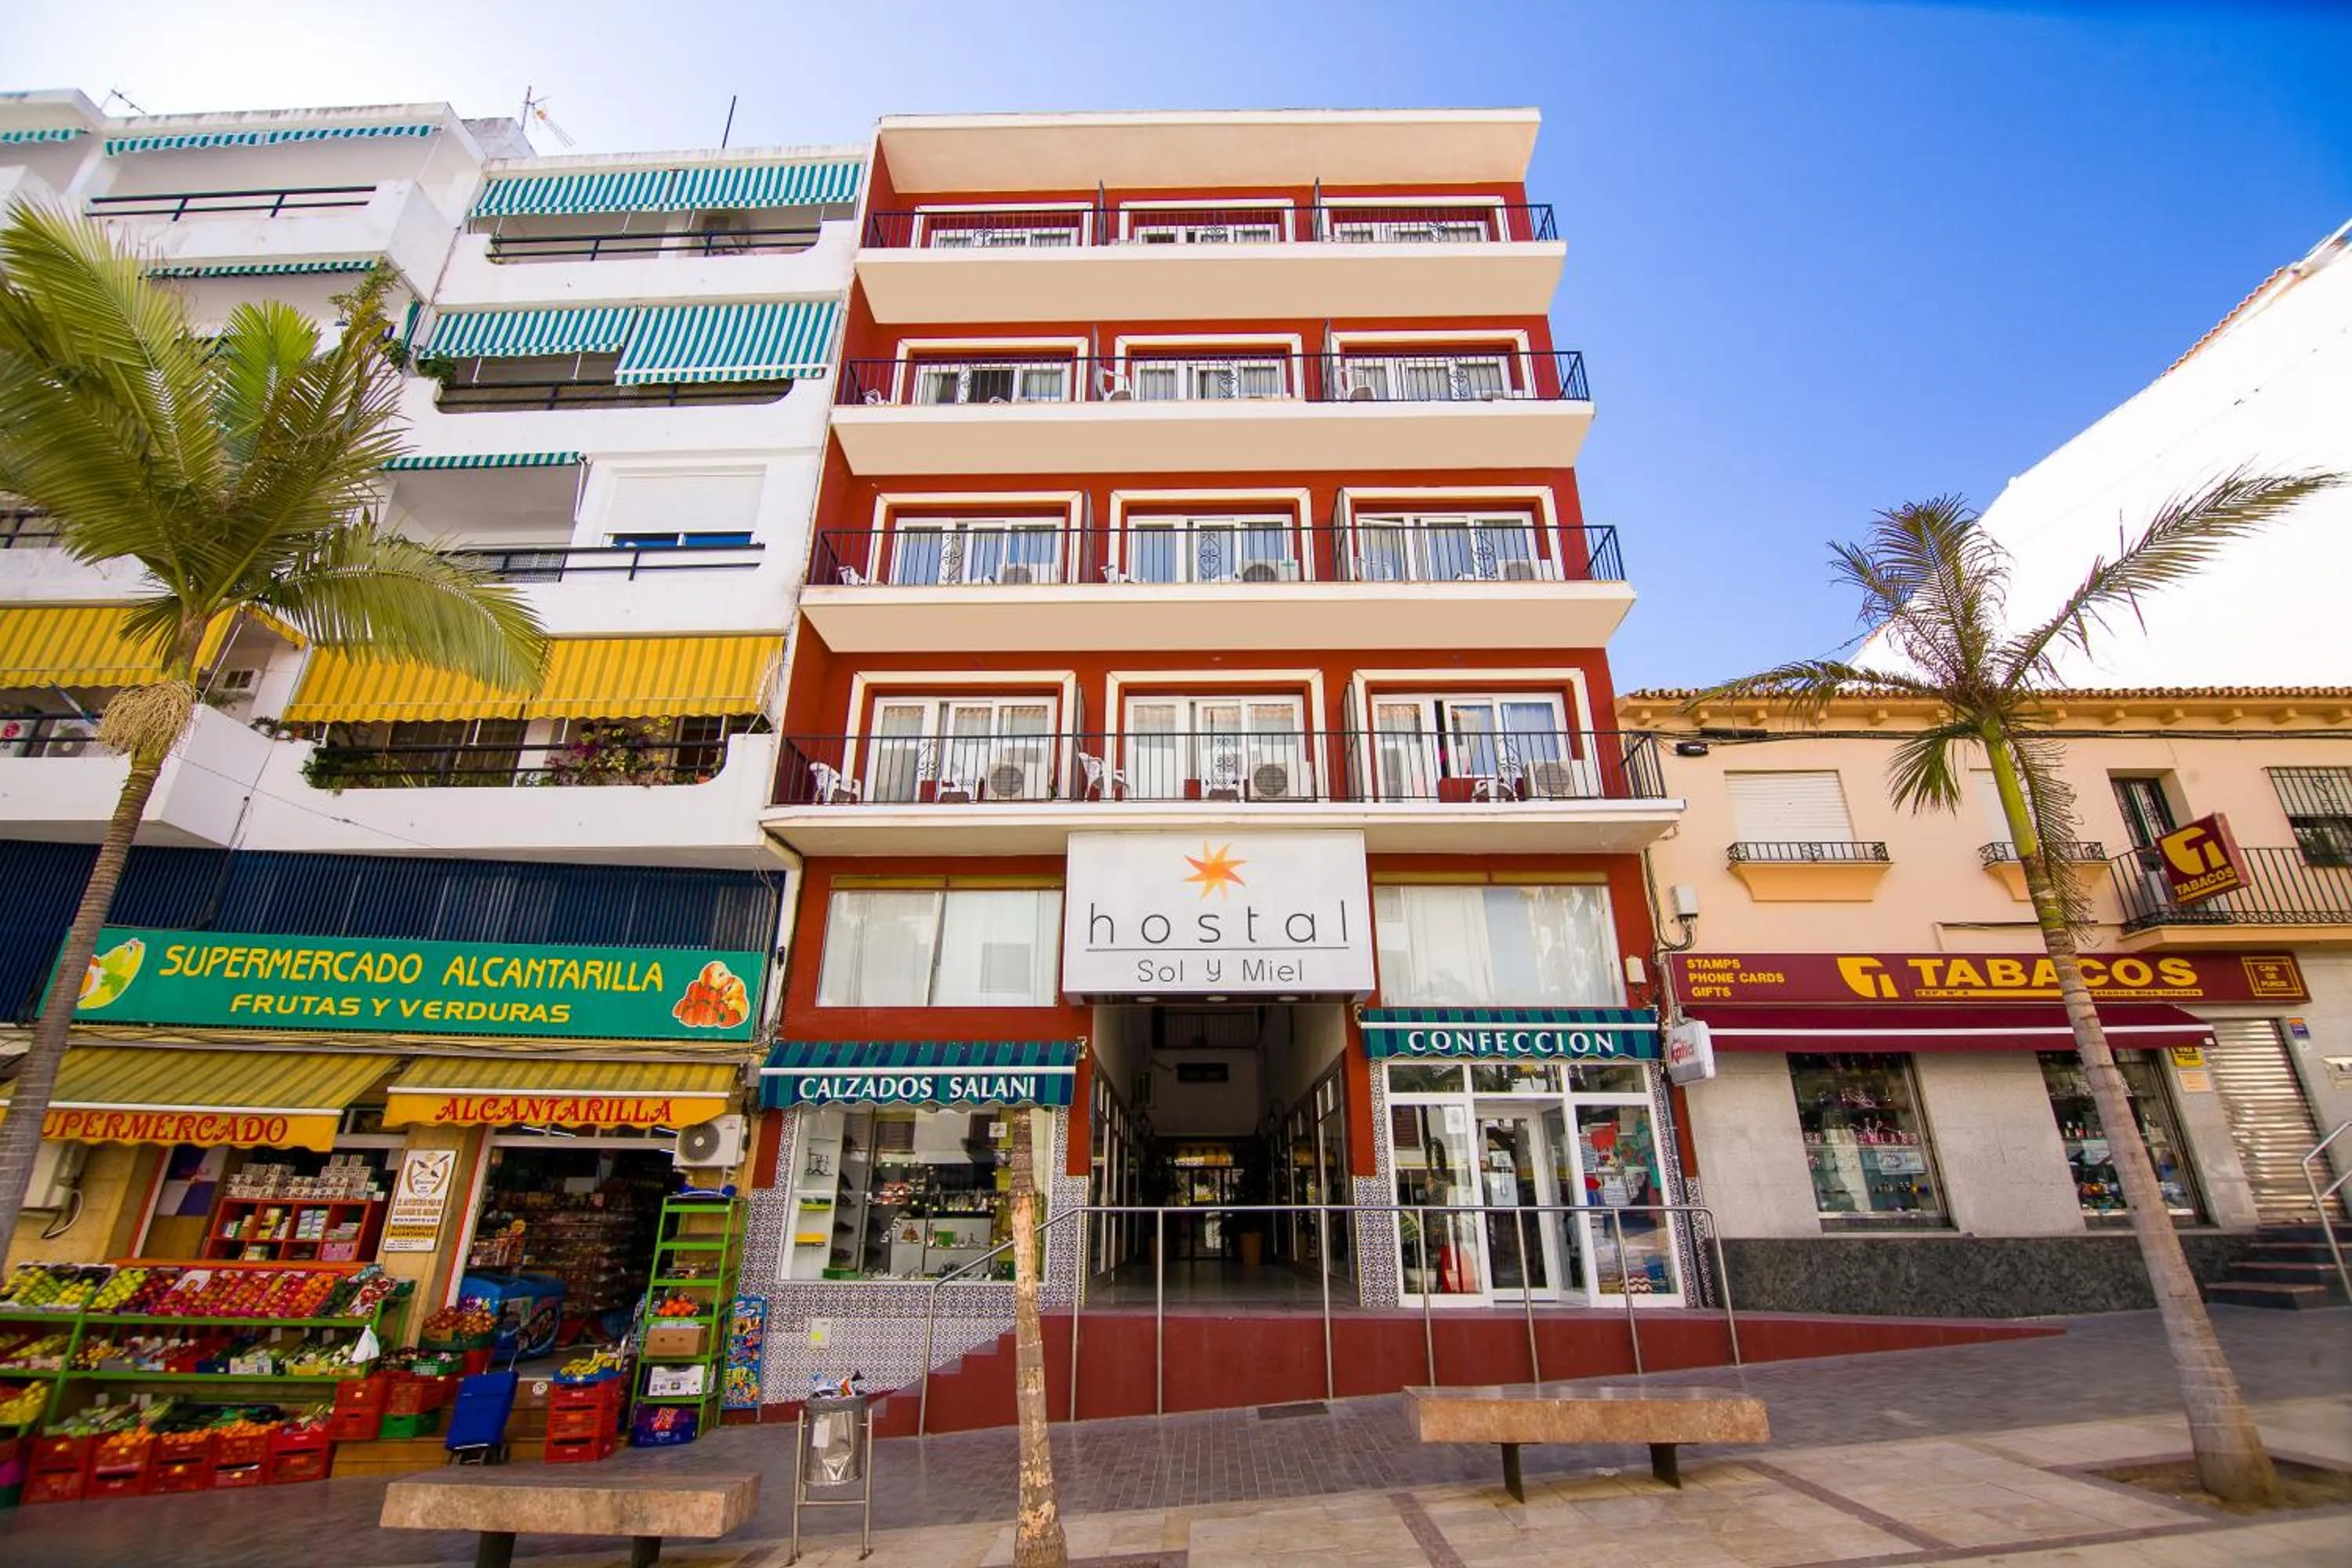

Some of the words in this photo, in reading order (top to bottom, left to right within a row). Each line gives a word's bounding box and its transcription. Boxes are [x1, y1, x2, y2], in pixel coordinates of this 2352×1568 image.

[2174, 866, 2235, 895] TABACOS
[1089, 900, 1348, 944] hostal
[159, 944, 423, 985] SUPERMERCADO
[441, 954, 663, 993] ALCANTARILLA
[1137, 958, 1184, 983] Sol
[1242, 958, 1304, 982] Miel
[1686, 958, 1741, 970] STAMPS
[1907, 957, 2198, 988] TABACOS
[1688, 972, 1735, 984] PHONE
[1739, 972, 1785, 984] CARDS
[1691, 985, 1732, 998] GIFTS
[230, 993, 361, 1017] FRUTAS
[371, 997, 391, 1018] Y
[399, 998, 571, 1024] VERDURAS
[1407, 1030, 1614, 1054] CONFECCION
[798, 1076, 933, 1099] CALZADOS
[949, 1075, 1036, 1098] SALANI
[434, 1098, 673, 1123] ALCANTARILLA
[42, 1109, 289, 1143] UPERMERCADO
